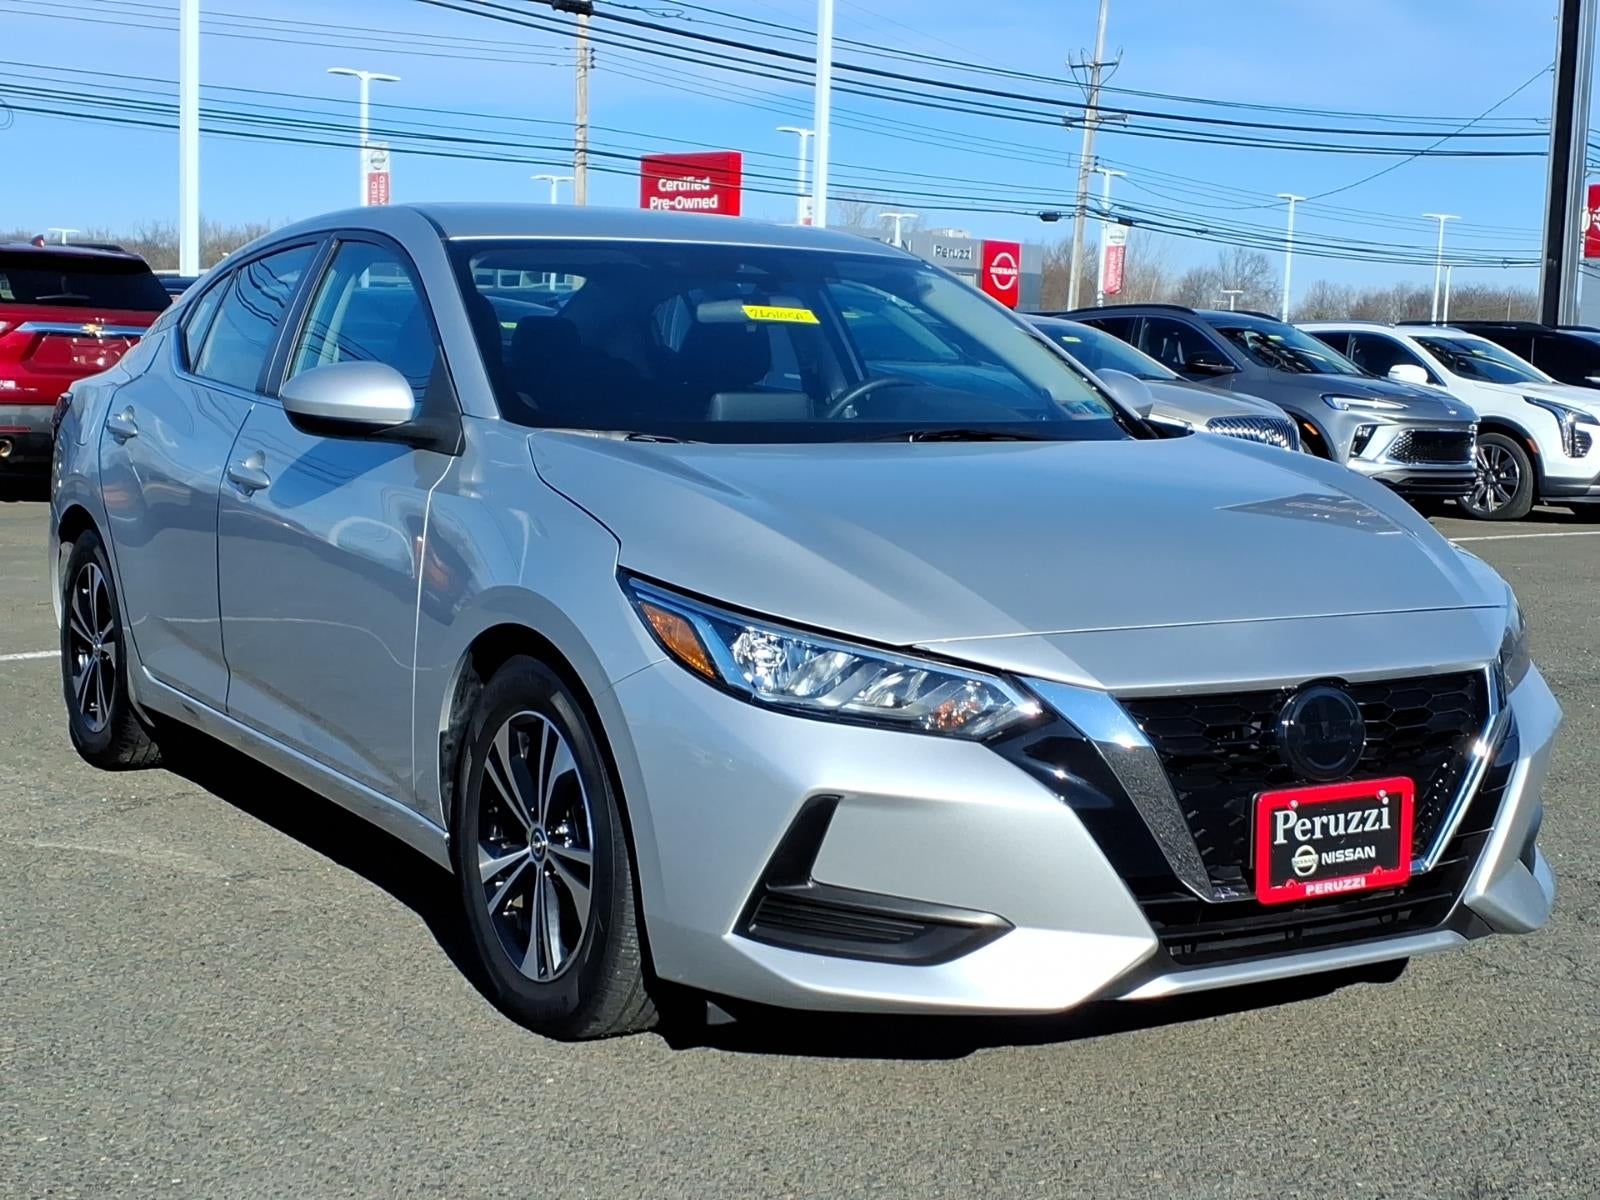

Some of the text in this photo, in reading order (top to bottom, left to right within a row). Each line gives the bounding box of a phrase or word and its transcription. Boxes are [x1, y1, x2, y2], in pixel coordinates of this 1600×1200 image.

[658, 176, 710, 192] Certified
[650, 194, 718, 210] Pre-Owned
[933, 243, 972, 260] Peruzzi
[989, 266, 1018, 276] NISSAN
[1273, 797, 1392, 845] Peruzzi
[1321, 845, 1376, 866] NISSAN
[1305, 876, 1367, 896] PERUZZI
